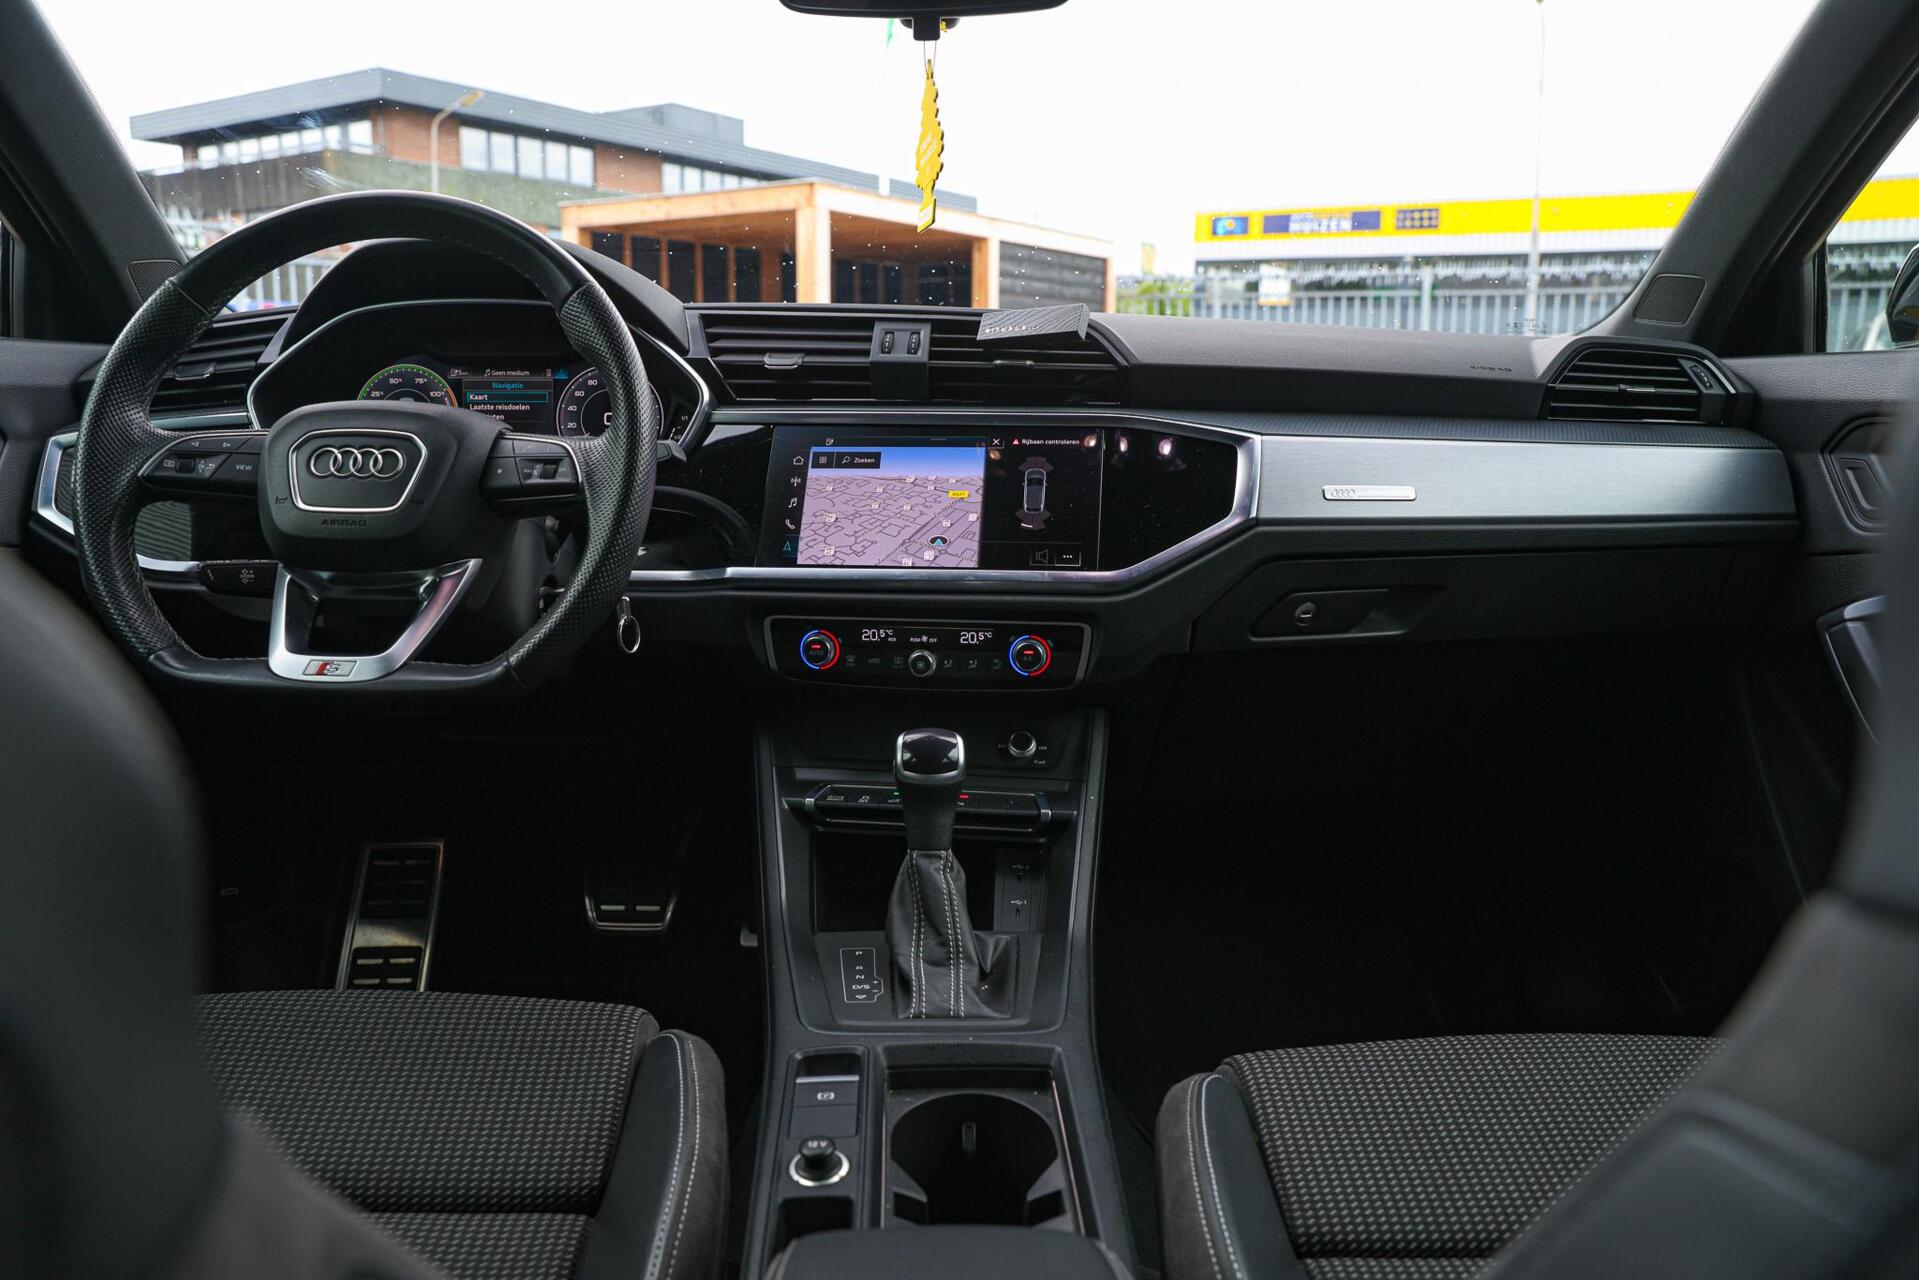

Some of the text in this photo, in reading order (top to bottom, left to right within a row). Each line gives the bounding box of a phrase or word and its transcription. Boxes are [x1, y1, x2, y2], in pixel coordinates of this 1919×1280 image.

[492, 382, 524, 391] Navigatie
[469, 393, 488, 401] Kaart
[853, 457, 876, 465] Zoeken
[235, 463, 253, 471] VIEW
[320, 518, 368, 527] AIRBAG
